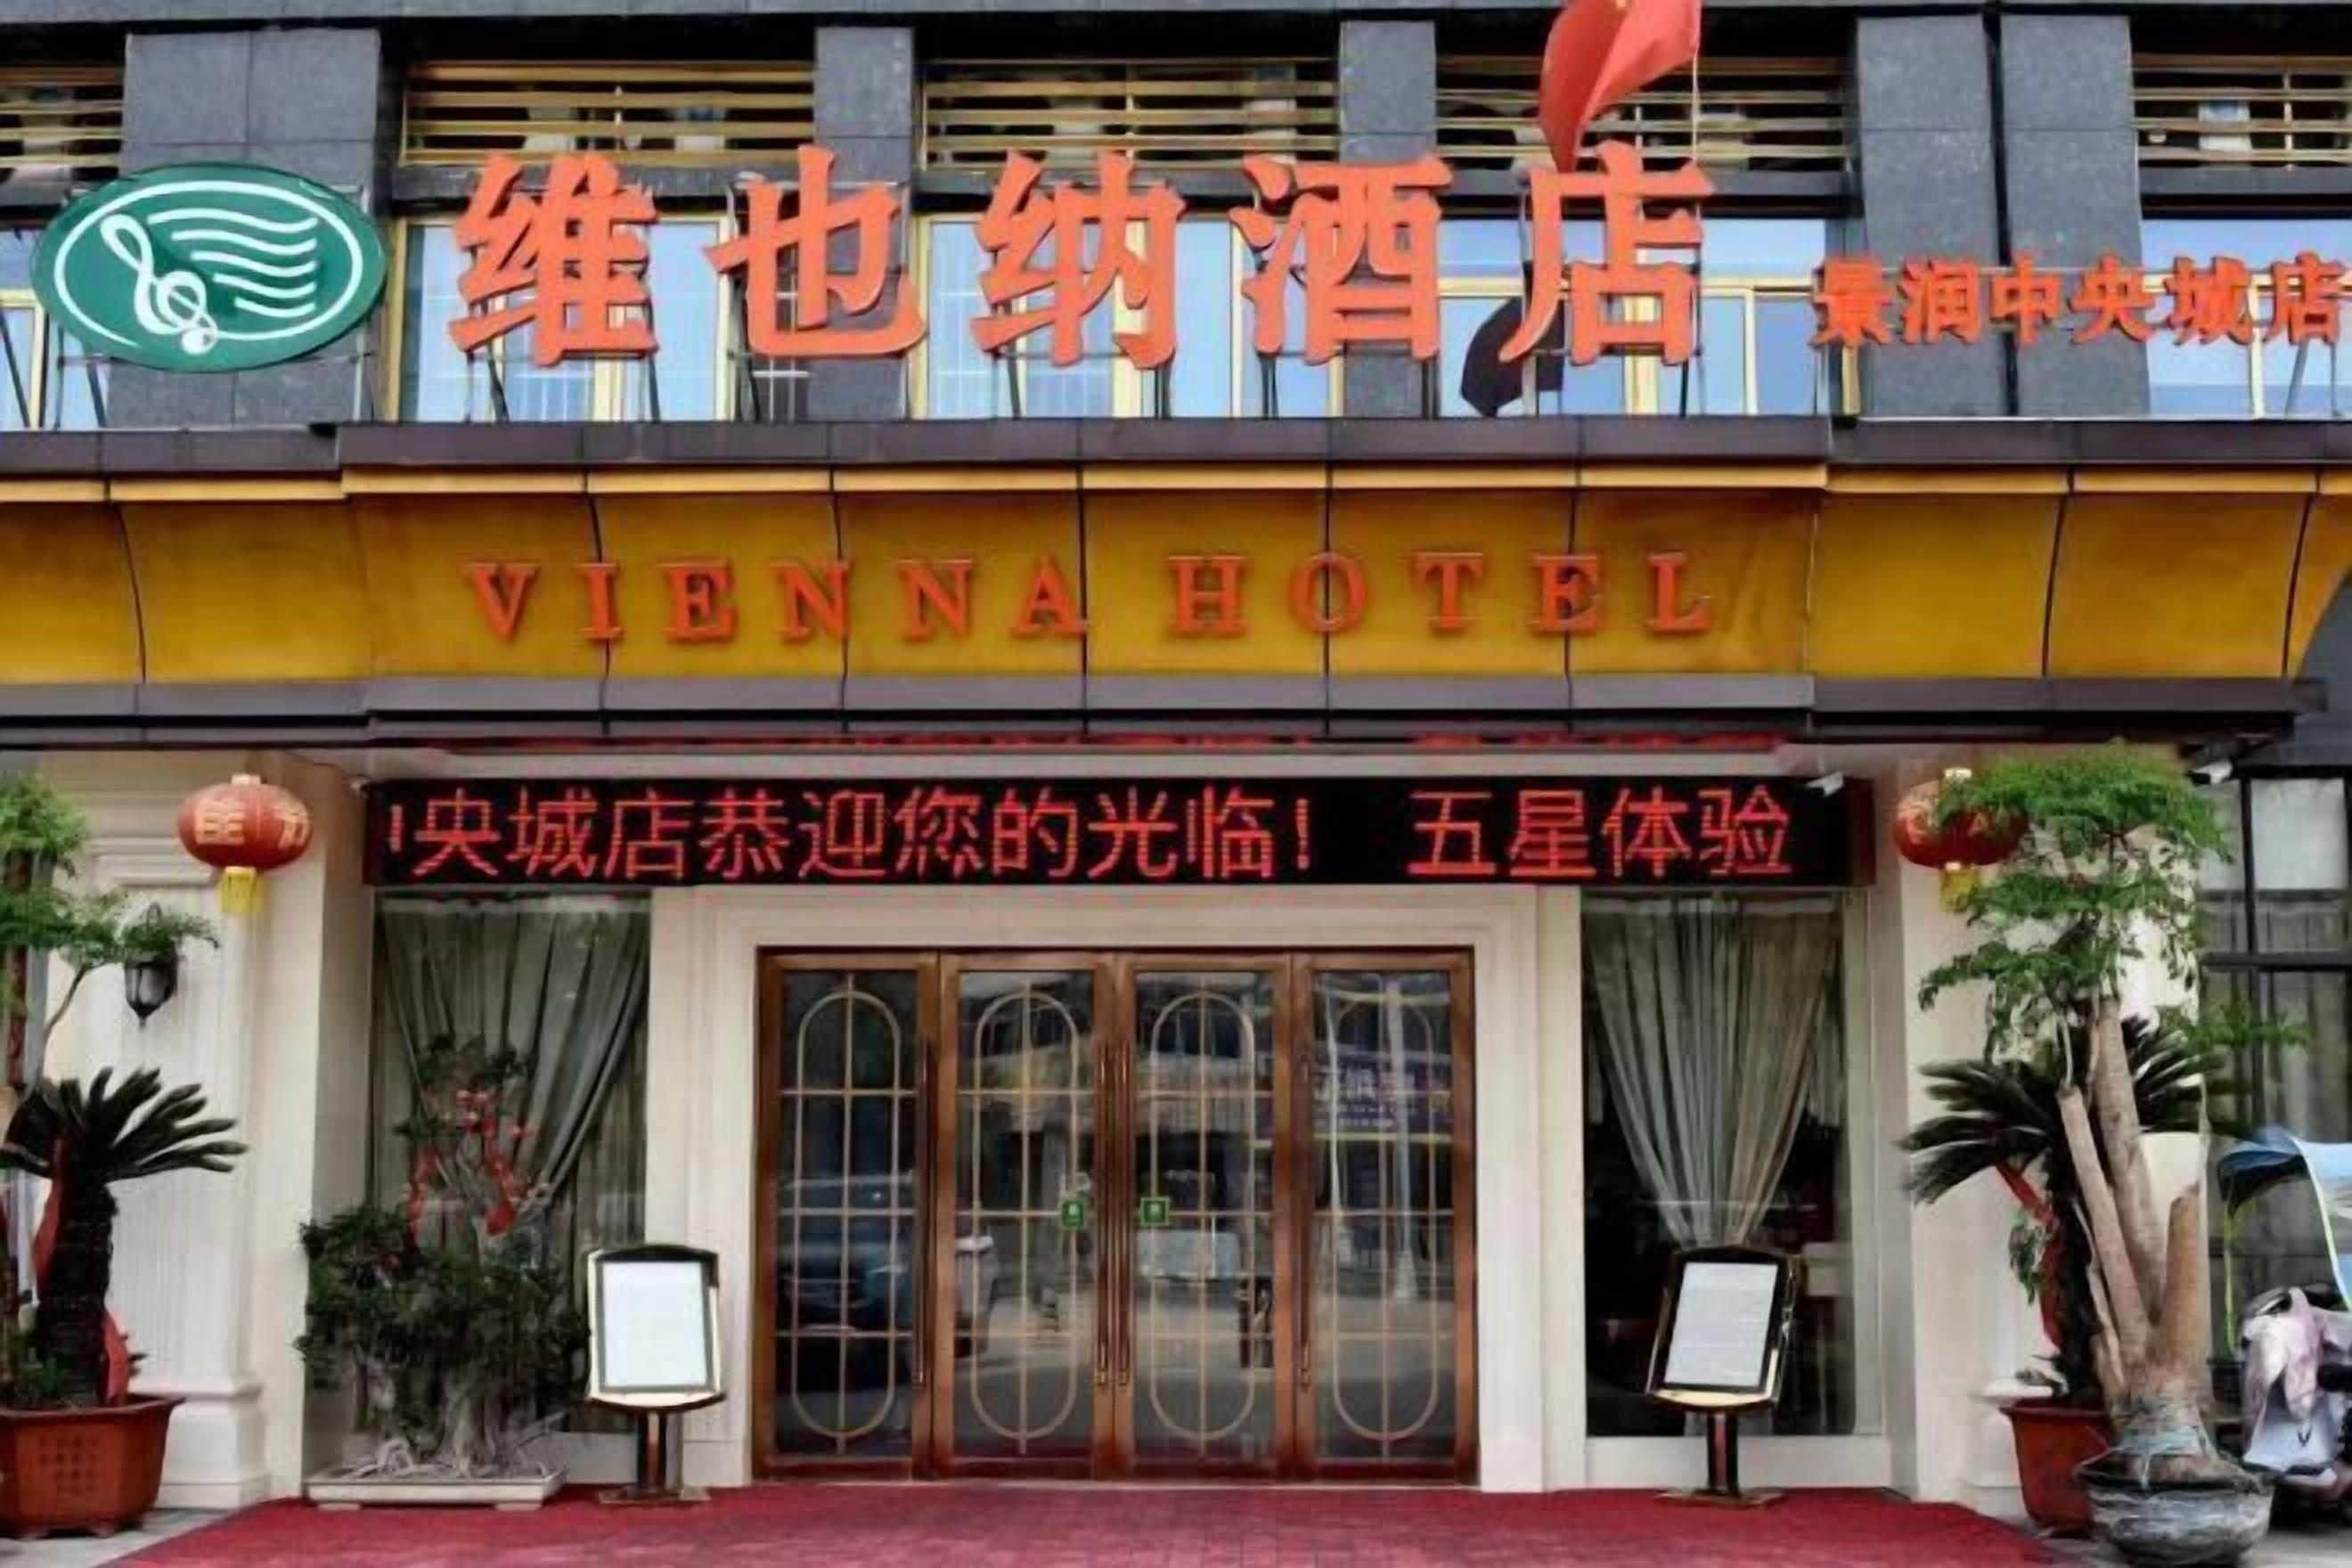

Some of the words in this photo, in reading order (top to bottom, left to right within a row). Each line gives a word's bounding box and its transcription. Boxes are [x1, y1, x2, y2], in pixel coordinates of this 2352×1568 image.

[452, 143, 1711, 365] 维也纳酒店
[1814, 250, 2344, 346] 景润中央城店
[463, 559, 1088, 641] VIENNA
[1169, 552, 1711, 635] HOTEL
[390, 788, 1308, 878] 央城店恭迎您的光临!
[1409, 788, 1789, 876] 五星体验
